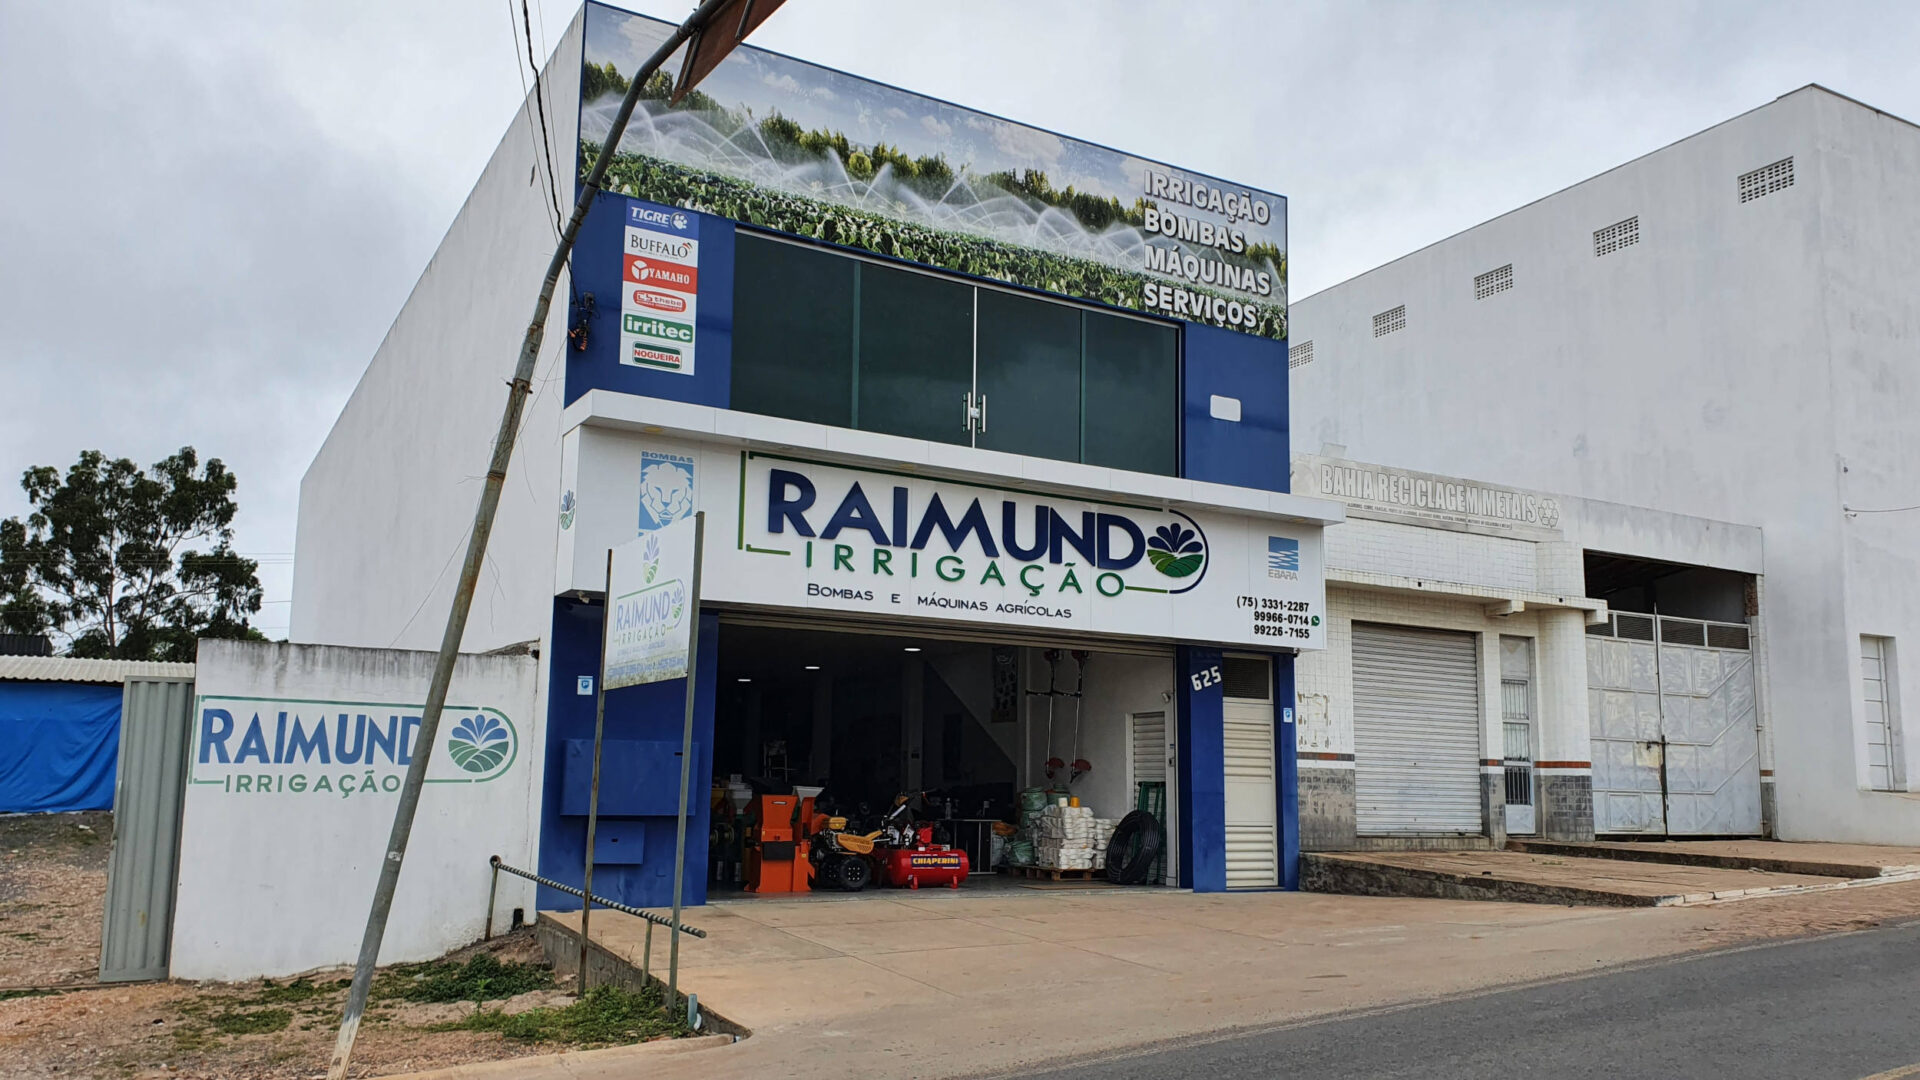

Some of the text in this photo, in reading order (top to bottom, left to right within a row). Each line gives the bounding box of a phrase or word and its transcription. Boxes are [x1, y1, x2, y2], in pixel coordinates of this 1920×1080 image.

[1144, 169, 1270, 225] IRRIGAÇÃO
[631, 206, 671, 225] TIGRE
[1144, 207, 1244, 254] BOMBAS
[631, 234, 688, 258] BUFFALO
[649, 267, 690, 284] YAMAHO
[1144, 244, 1271, 296] MÁQUINAS
[1144, 283, 1258, 328] SERVIÇOS
[626, 316, 691, 340] irritec
[634, 349, 681, 363] NOGUEIRA
[641, 450, 694, 464] BOMBAS
[1320, 463, 1376, 500] BAHIA
[1482, 487, 1537, 524] METAIS
[767, 467, 1147, 571] RAIMUND
[806, 541, 1125, 598] IRRIGAÇÃO
[1268, 569, 1298, 581] EBARA
[616, 590, 670, 632] RAIMUND
[1236, 595, 1310, 612] (75) 3331-2287
[1254, 610, 1309, 626] 99966-0714
[1254, 624, 1310, 639] 99226-7155
[1190, 666, 1222, 691] 625
[225, 770, 401, 798] IRRIGAÇÃO
[912, 857, 959, 865] CHIAPERINI
